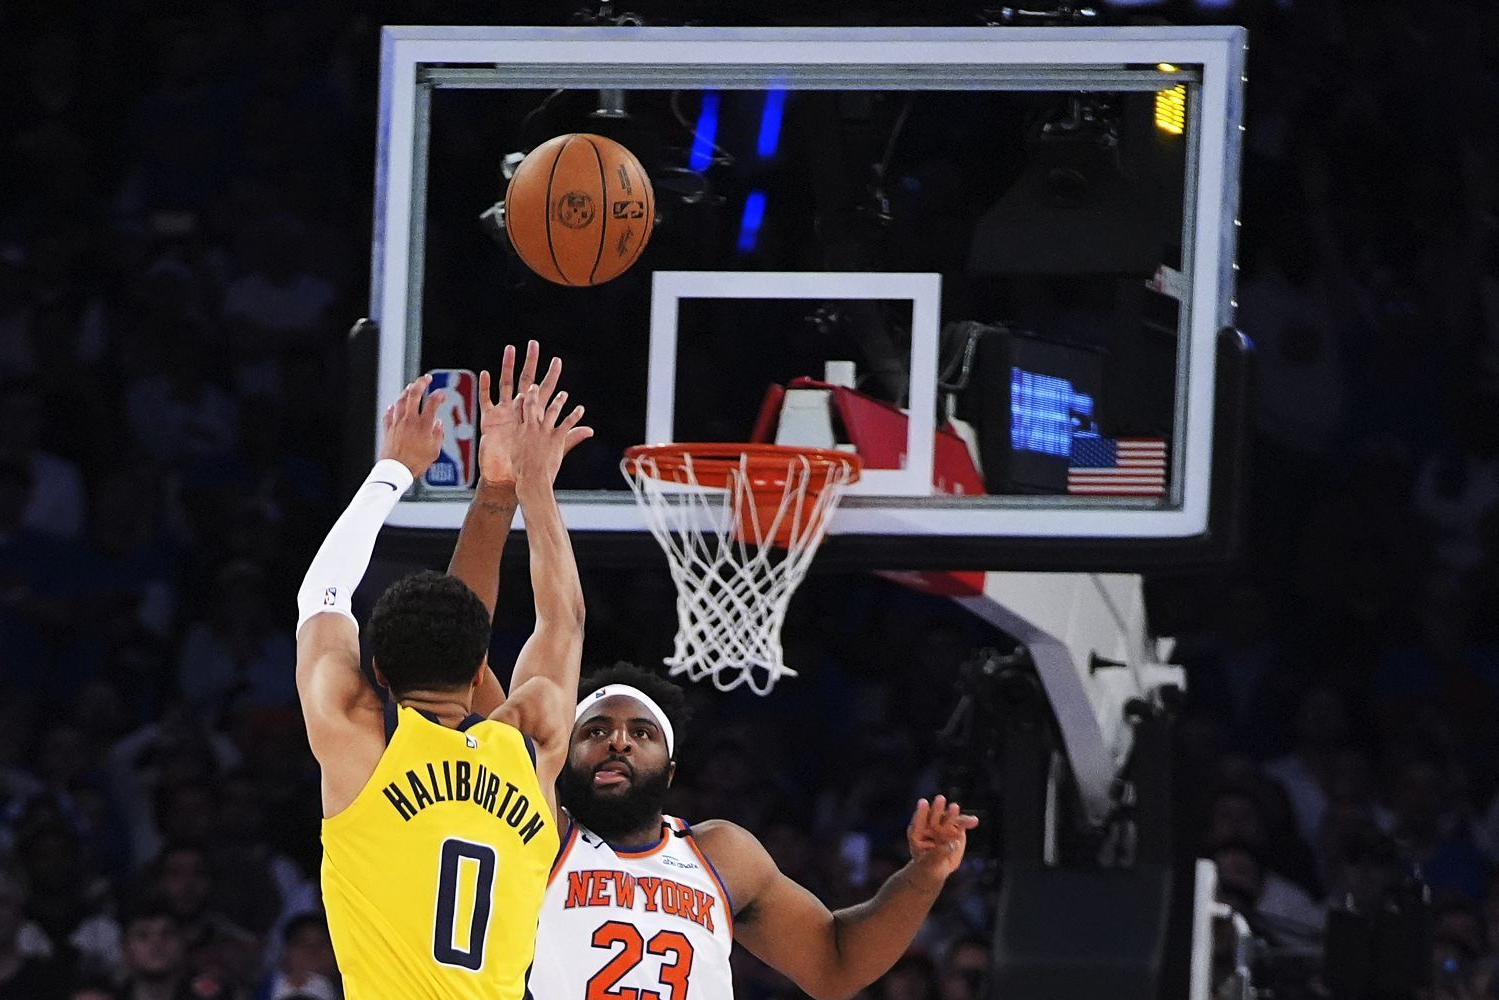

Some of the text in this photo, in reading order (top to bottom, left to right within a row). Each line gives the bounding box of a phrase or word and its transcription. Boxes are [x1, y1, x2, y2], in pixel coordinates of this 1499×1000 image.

[383, 760, 545, 846] HALIBURTON
[432, 837, 497, 972] 0
[564, 870, 716, 934] NEW YORK
